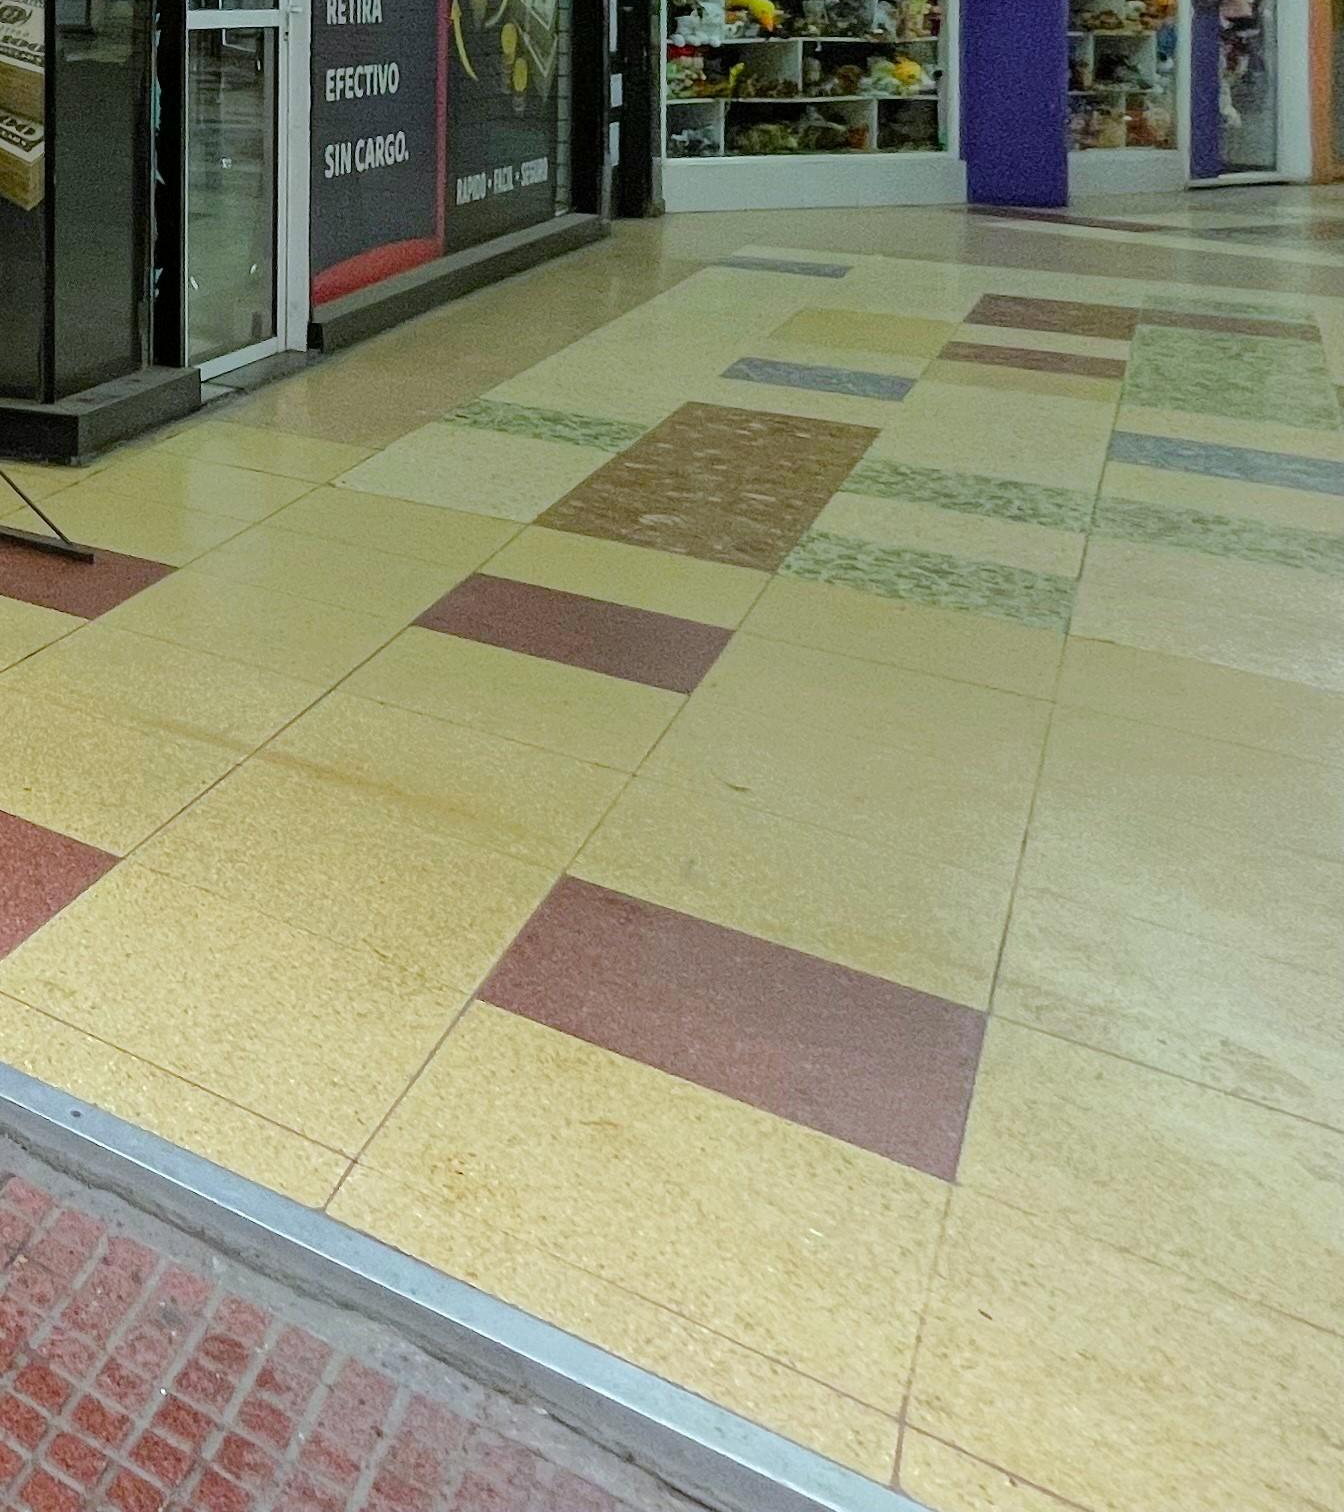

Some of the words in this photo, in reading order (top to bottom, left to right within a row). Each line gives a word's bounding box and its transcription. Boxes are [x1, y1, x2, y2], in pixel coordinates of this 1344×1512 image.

[325, 62, 400, 102] EFECTIVO
[324, 142, 352, 178] SIN
[354, 130, 409, 173] CARGO.
